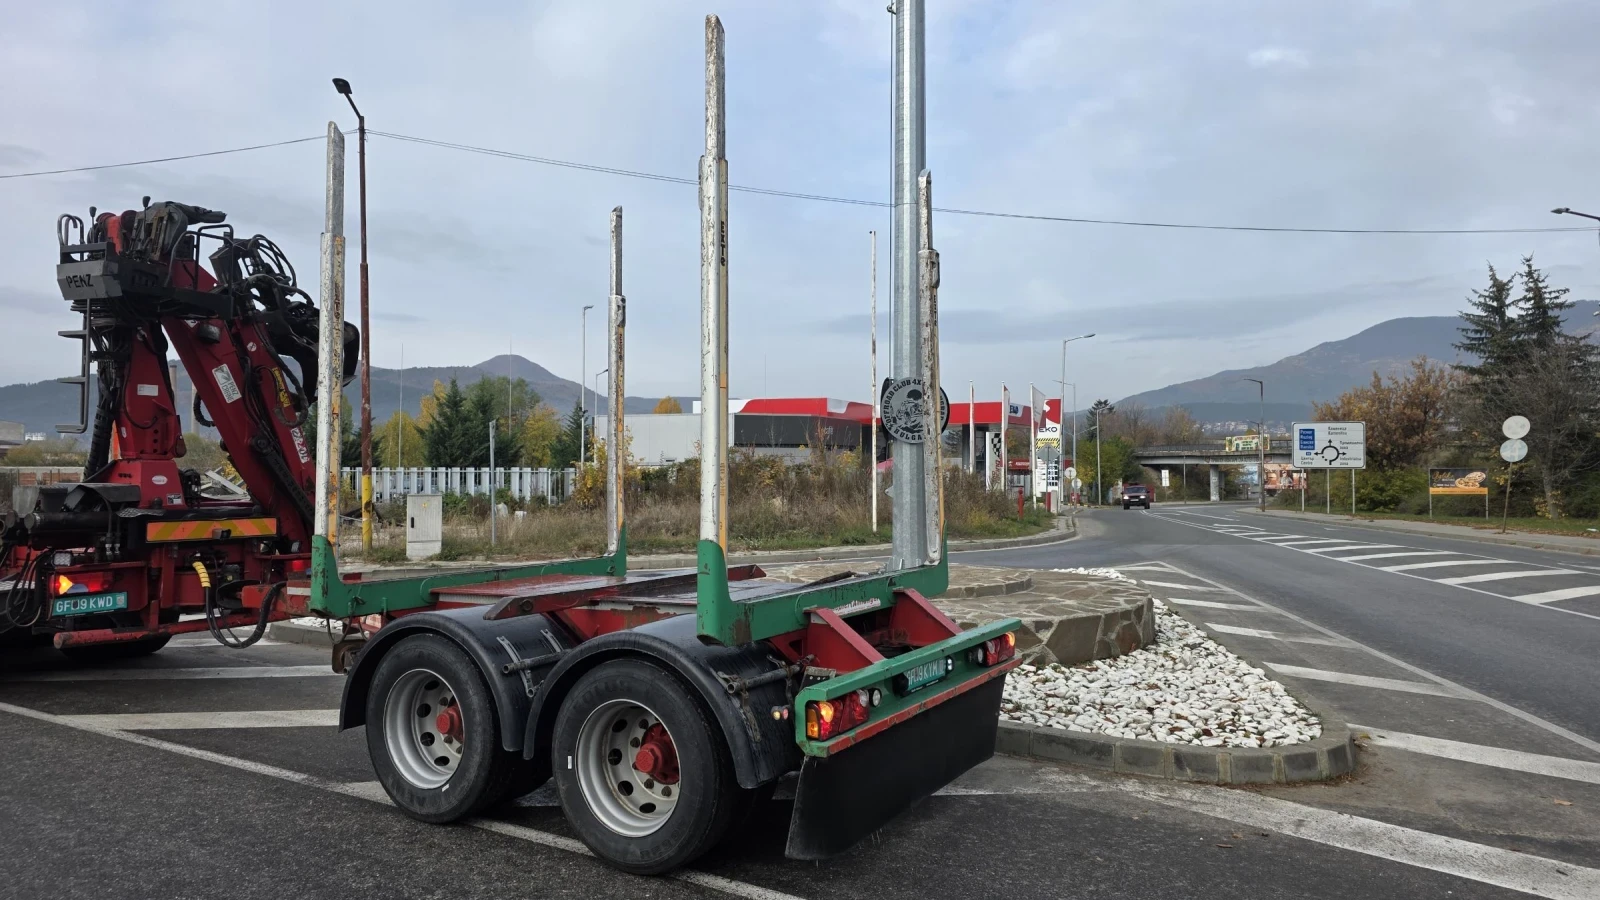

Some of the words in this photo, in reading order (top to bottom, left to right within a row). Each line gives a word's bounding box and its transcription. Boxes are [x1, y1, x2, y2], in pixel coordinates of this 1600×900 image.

[65, 273, 94, 289] PENZ
[228, 379, 239, 396] PENZ
[883, 390, 895, 424] OFFROAD
[893, 380, 911, 392] CLUB
[893, 429, 923, 441] BULGA
[56, 600, 71, 613] GF
[89, 596, 113, 609] KWD
